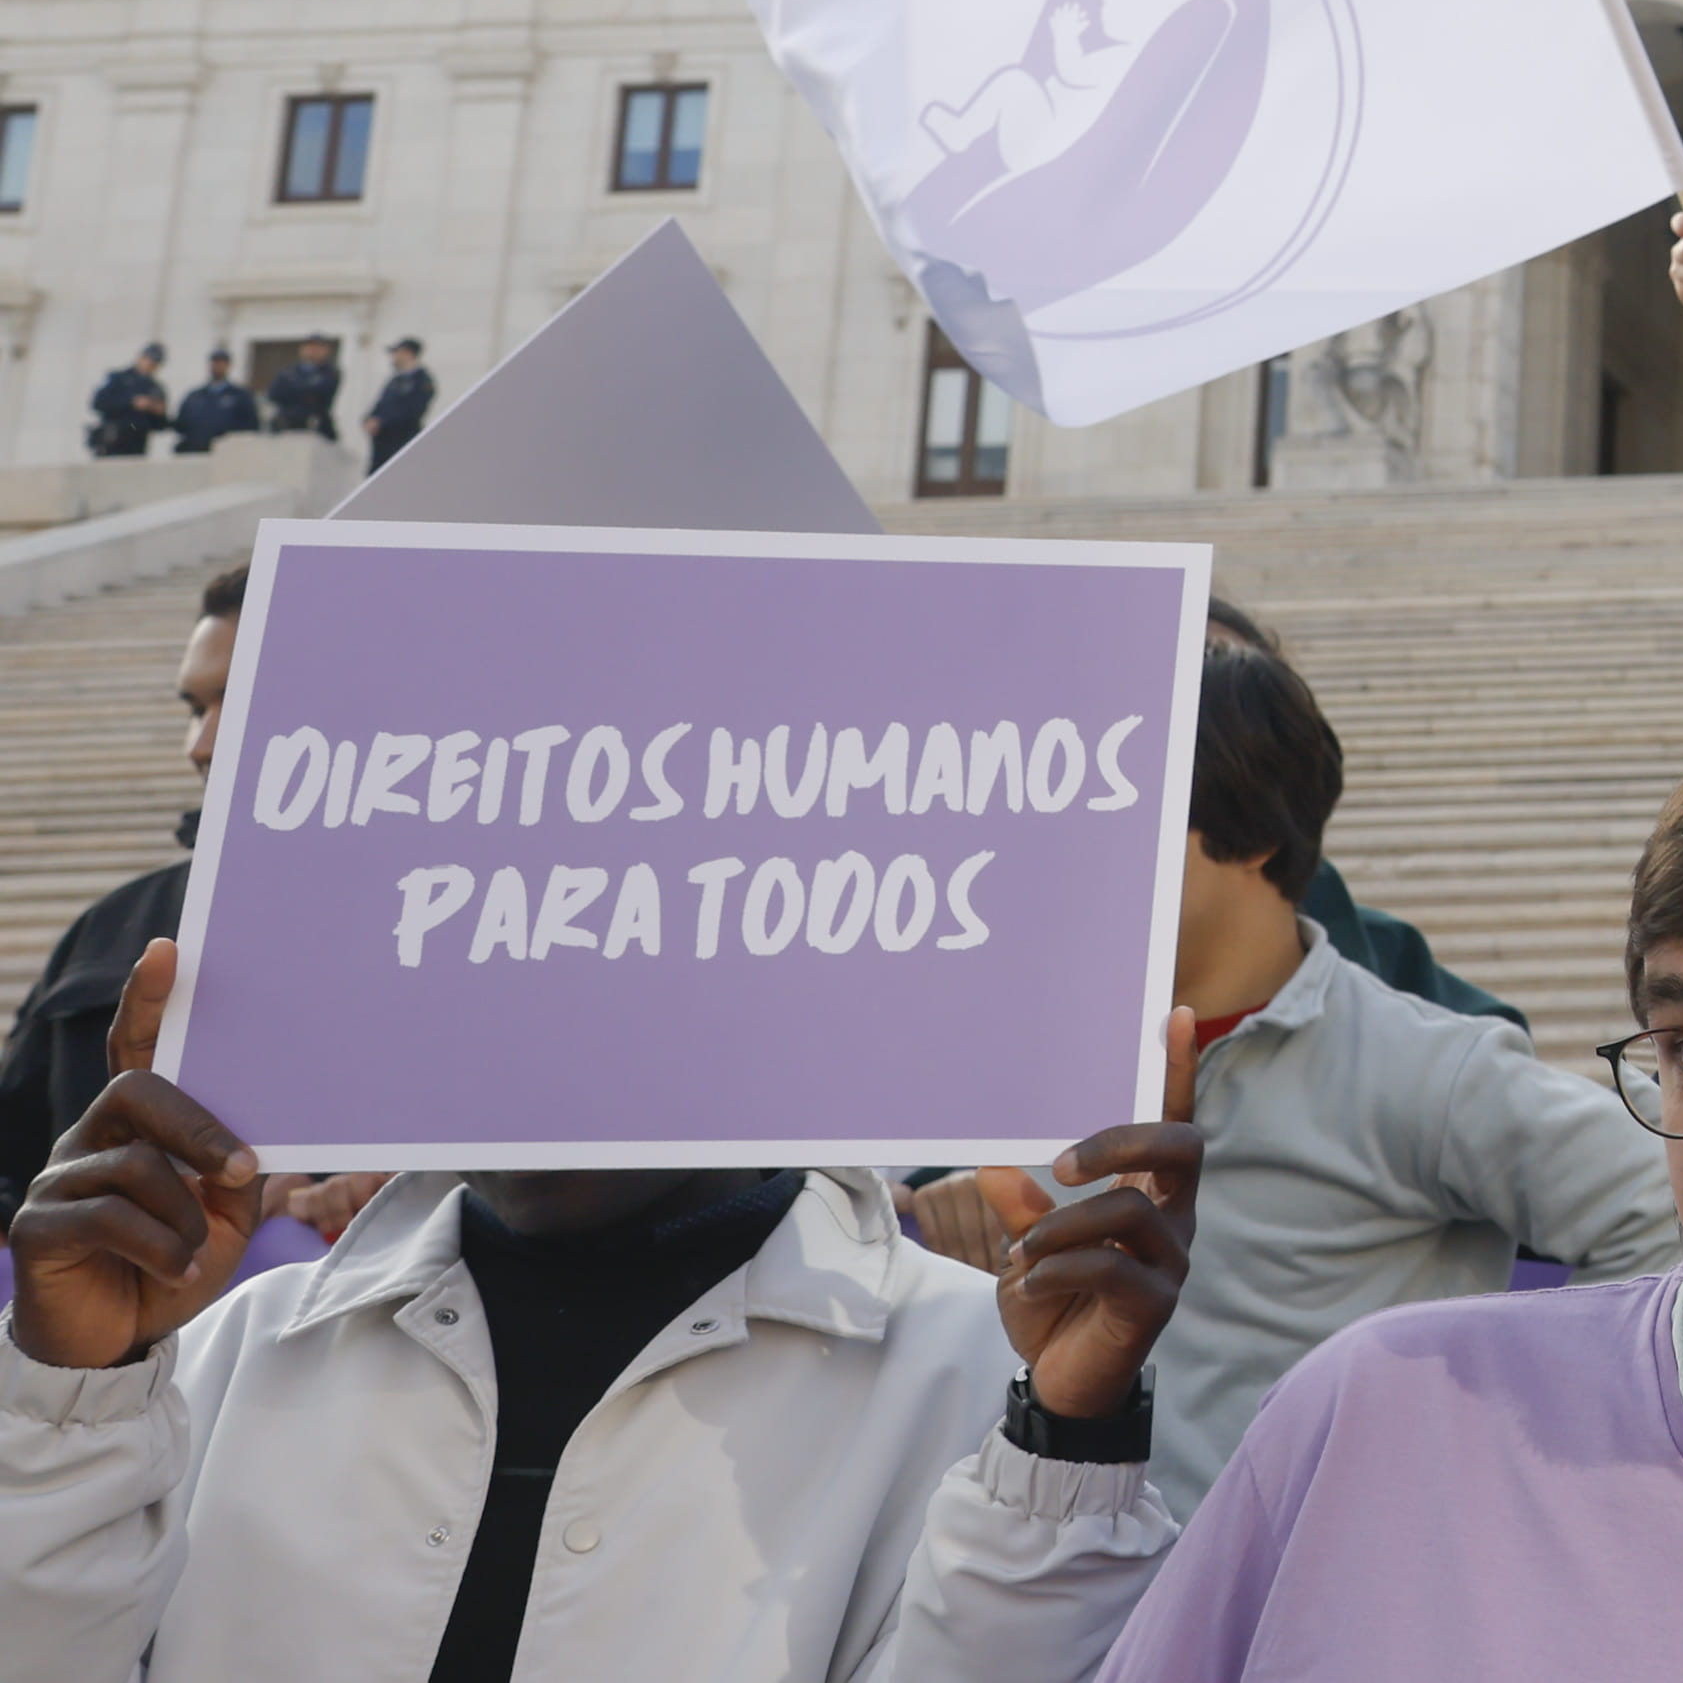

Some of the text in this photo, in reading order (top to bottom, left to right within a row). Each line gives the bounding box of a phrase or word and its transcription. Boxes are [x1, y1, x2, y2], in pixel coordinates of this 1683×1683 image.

[252, 716, 1145, 831] DIREITOS HUMANOS
[392, 849, 996, 968] PARA TODOS
